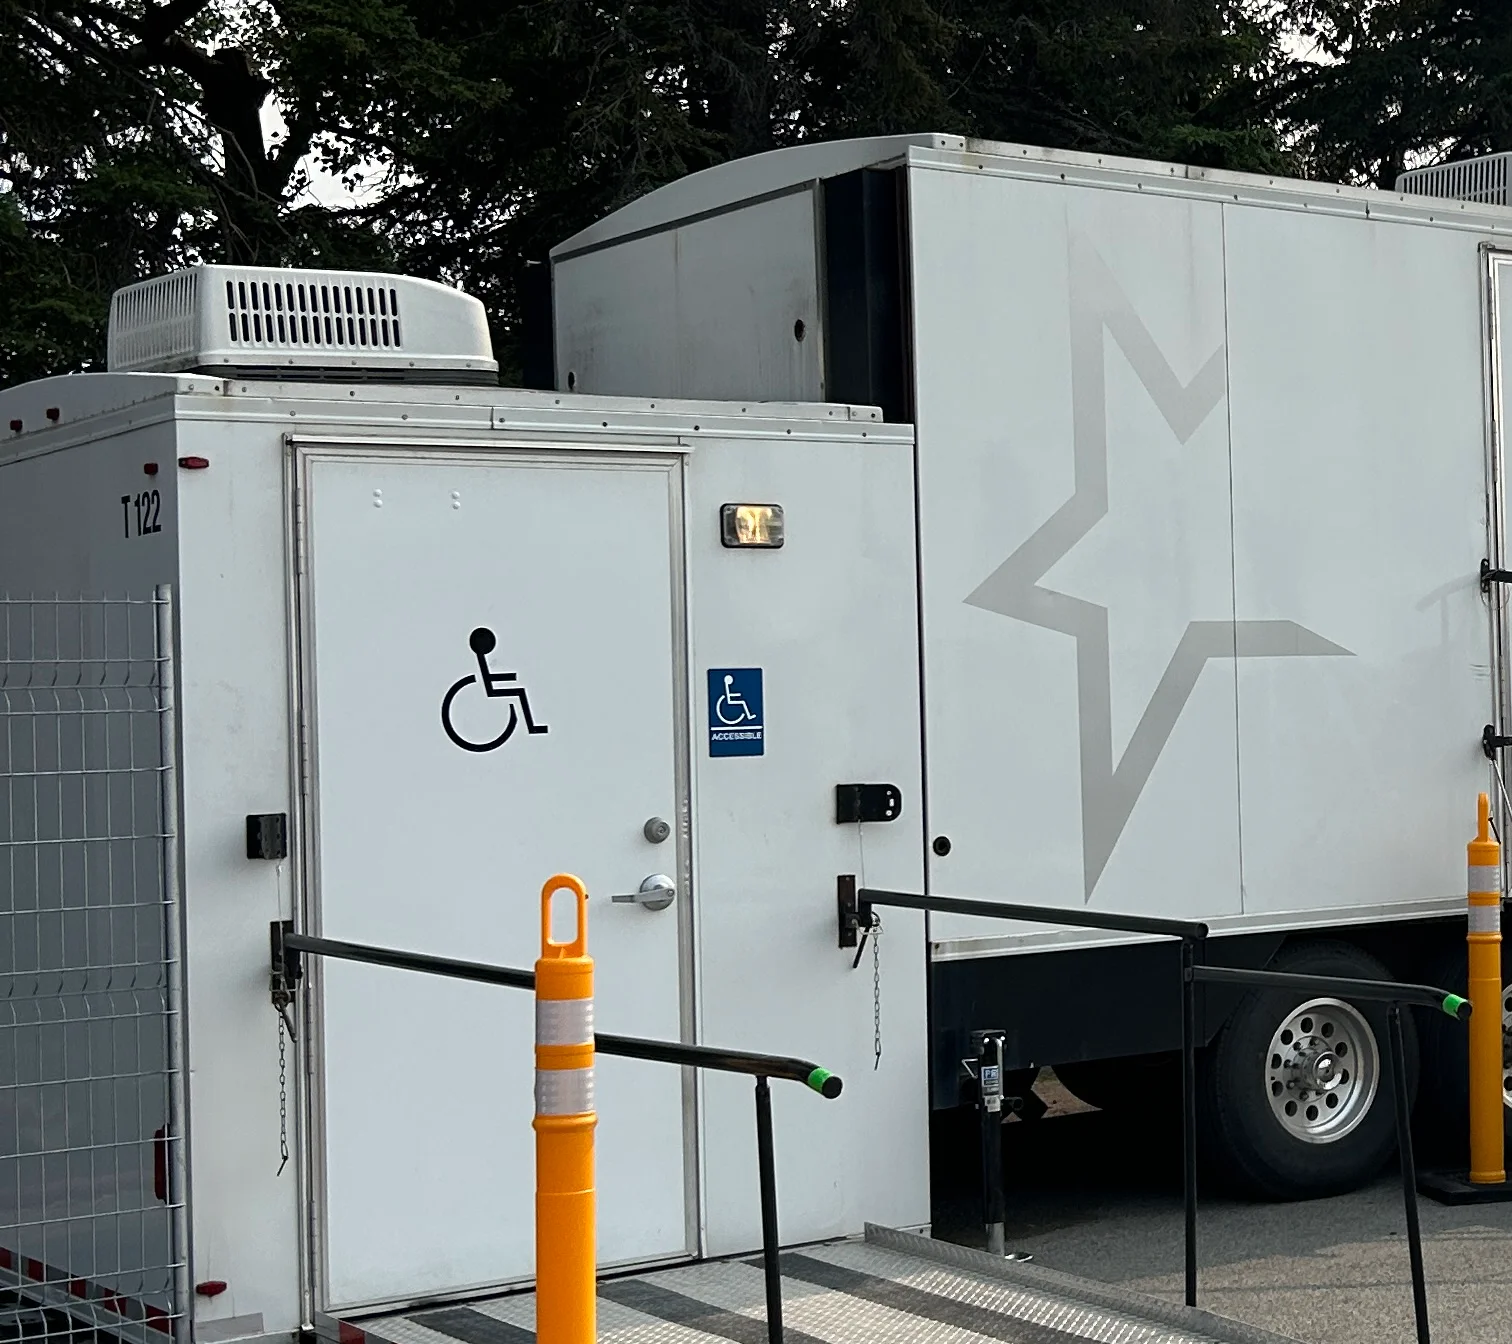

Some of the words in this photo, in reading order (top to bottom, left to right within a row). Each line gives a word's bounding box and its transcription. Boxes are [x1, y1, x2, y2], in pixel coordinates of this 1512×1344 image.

[121, 495, 131, 539] T
[134, 489, 162, 537] 122
[711, 732, 762, 741] ACCESSIBLE
